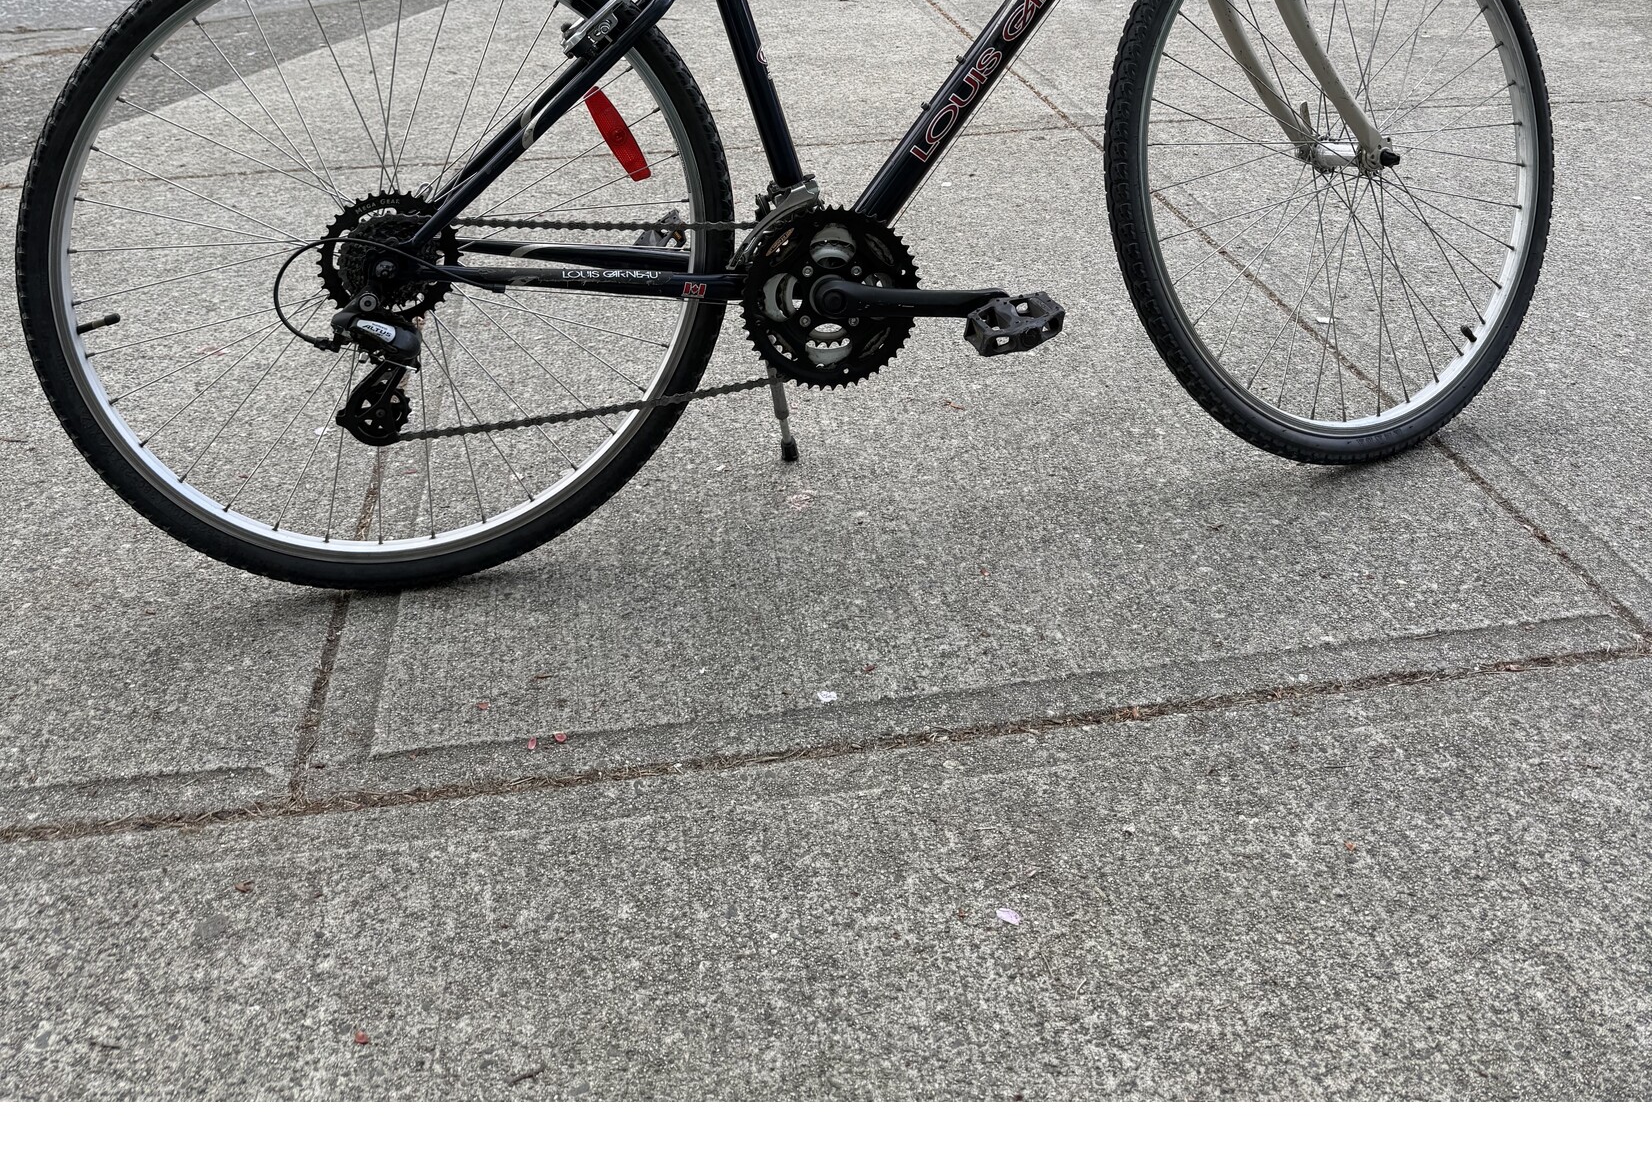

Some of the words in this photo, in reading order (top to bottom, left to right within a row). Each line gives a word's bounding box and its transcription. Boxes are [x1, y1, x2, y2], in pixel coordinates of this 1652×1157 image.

[909, 47, 1003, 163] LOUIS
[562, 270, 600, 279] LOUIS
[362, 324, 392, 338] ALTUS
